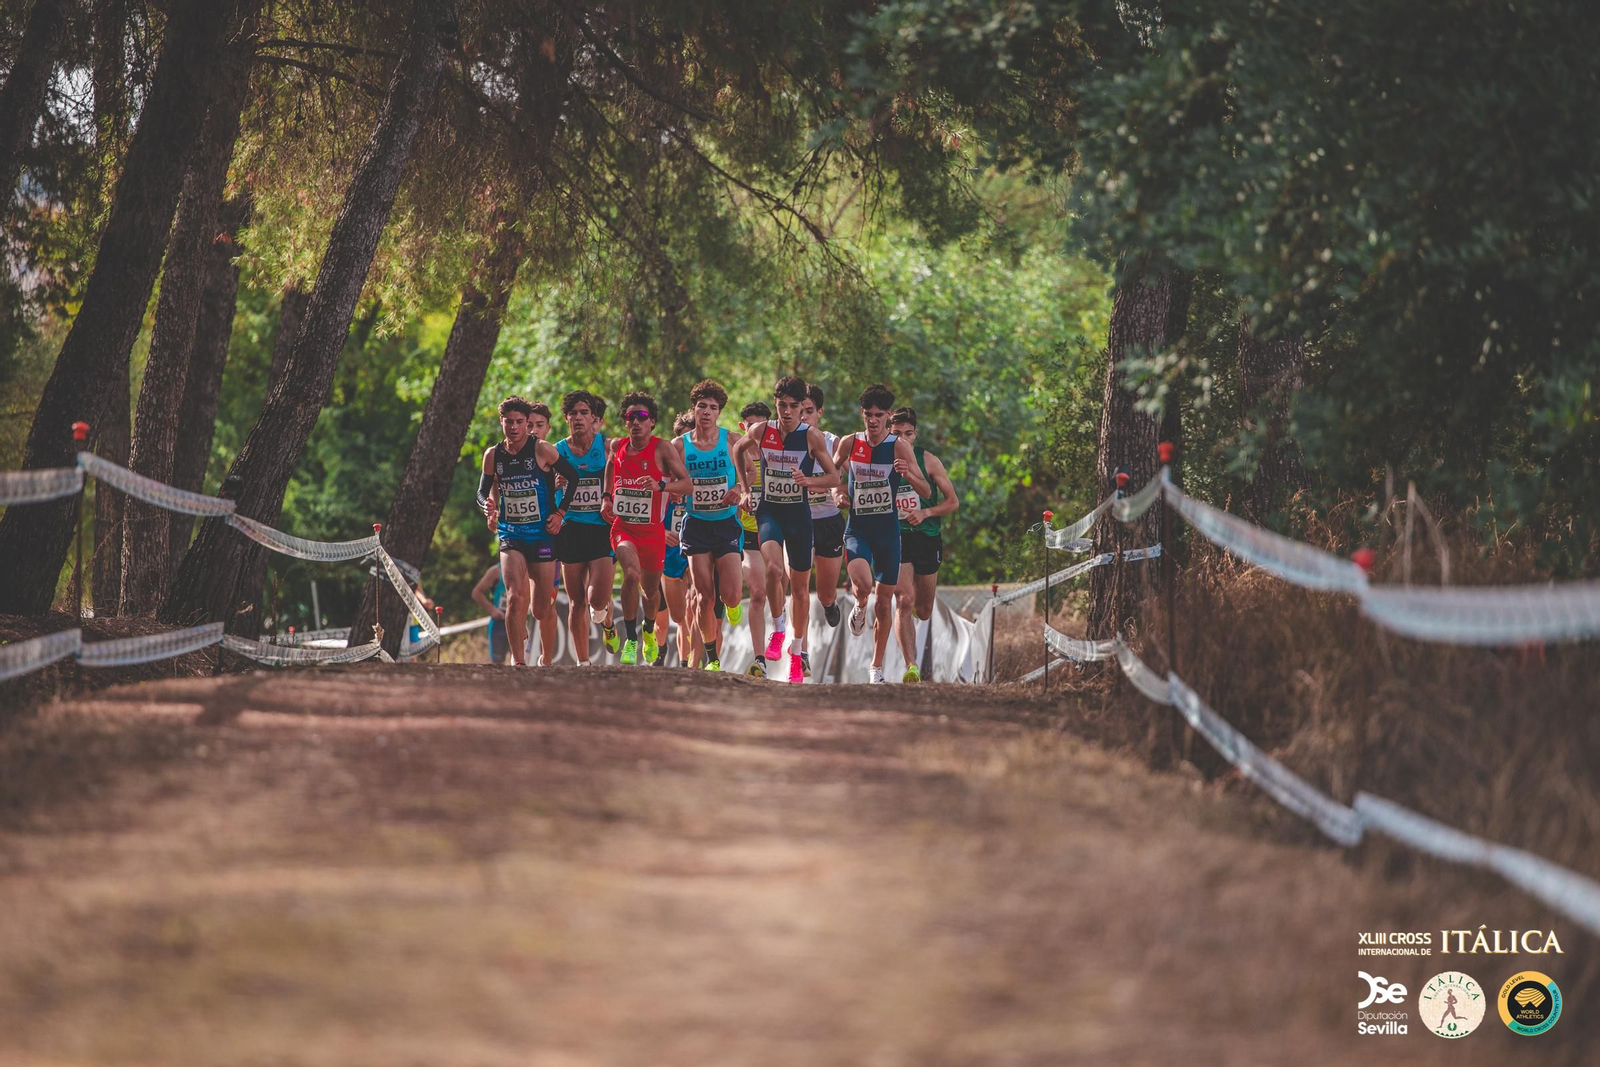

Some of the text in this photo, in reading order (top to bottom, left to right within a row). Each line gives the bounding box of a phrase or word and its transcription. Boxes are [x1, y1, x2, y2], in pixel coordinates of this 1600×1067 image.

[688, 457, 727, 472] nerja
[499, 478, 540, 491] NARÓN
[768, 482, 800, 495] 6400
[574, 491, 599, 503] 404
[695, 489, 726, 502] 8282
[858, 492, 891, 506] 6402
[507, 501, 537, 514] 6156
[616, 500, 650, 515] 6162
[896, 497, 918, 511] 405
